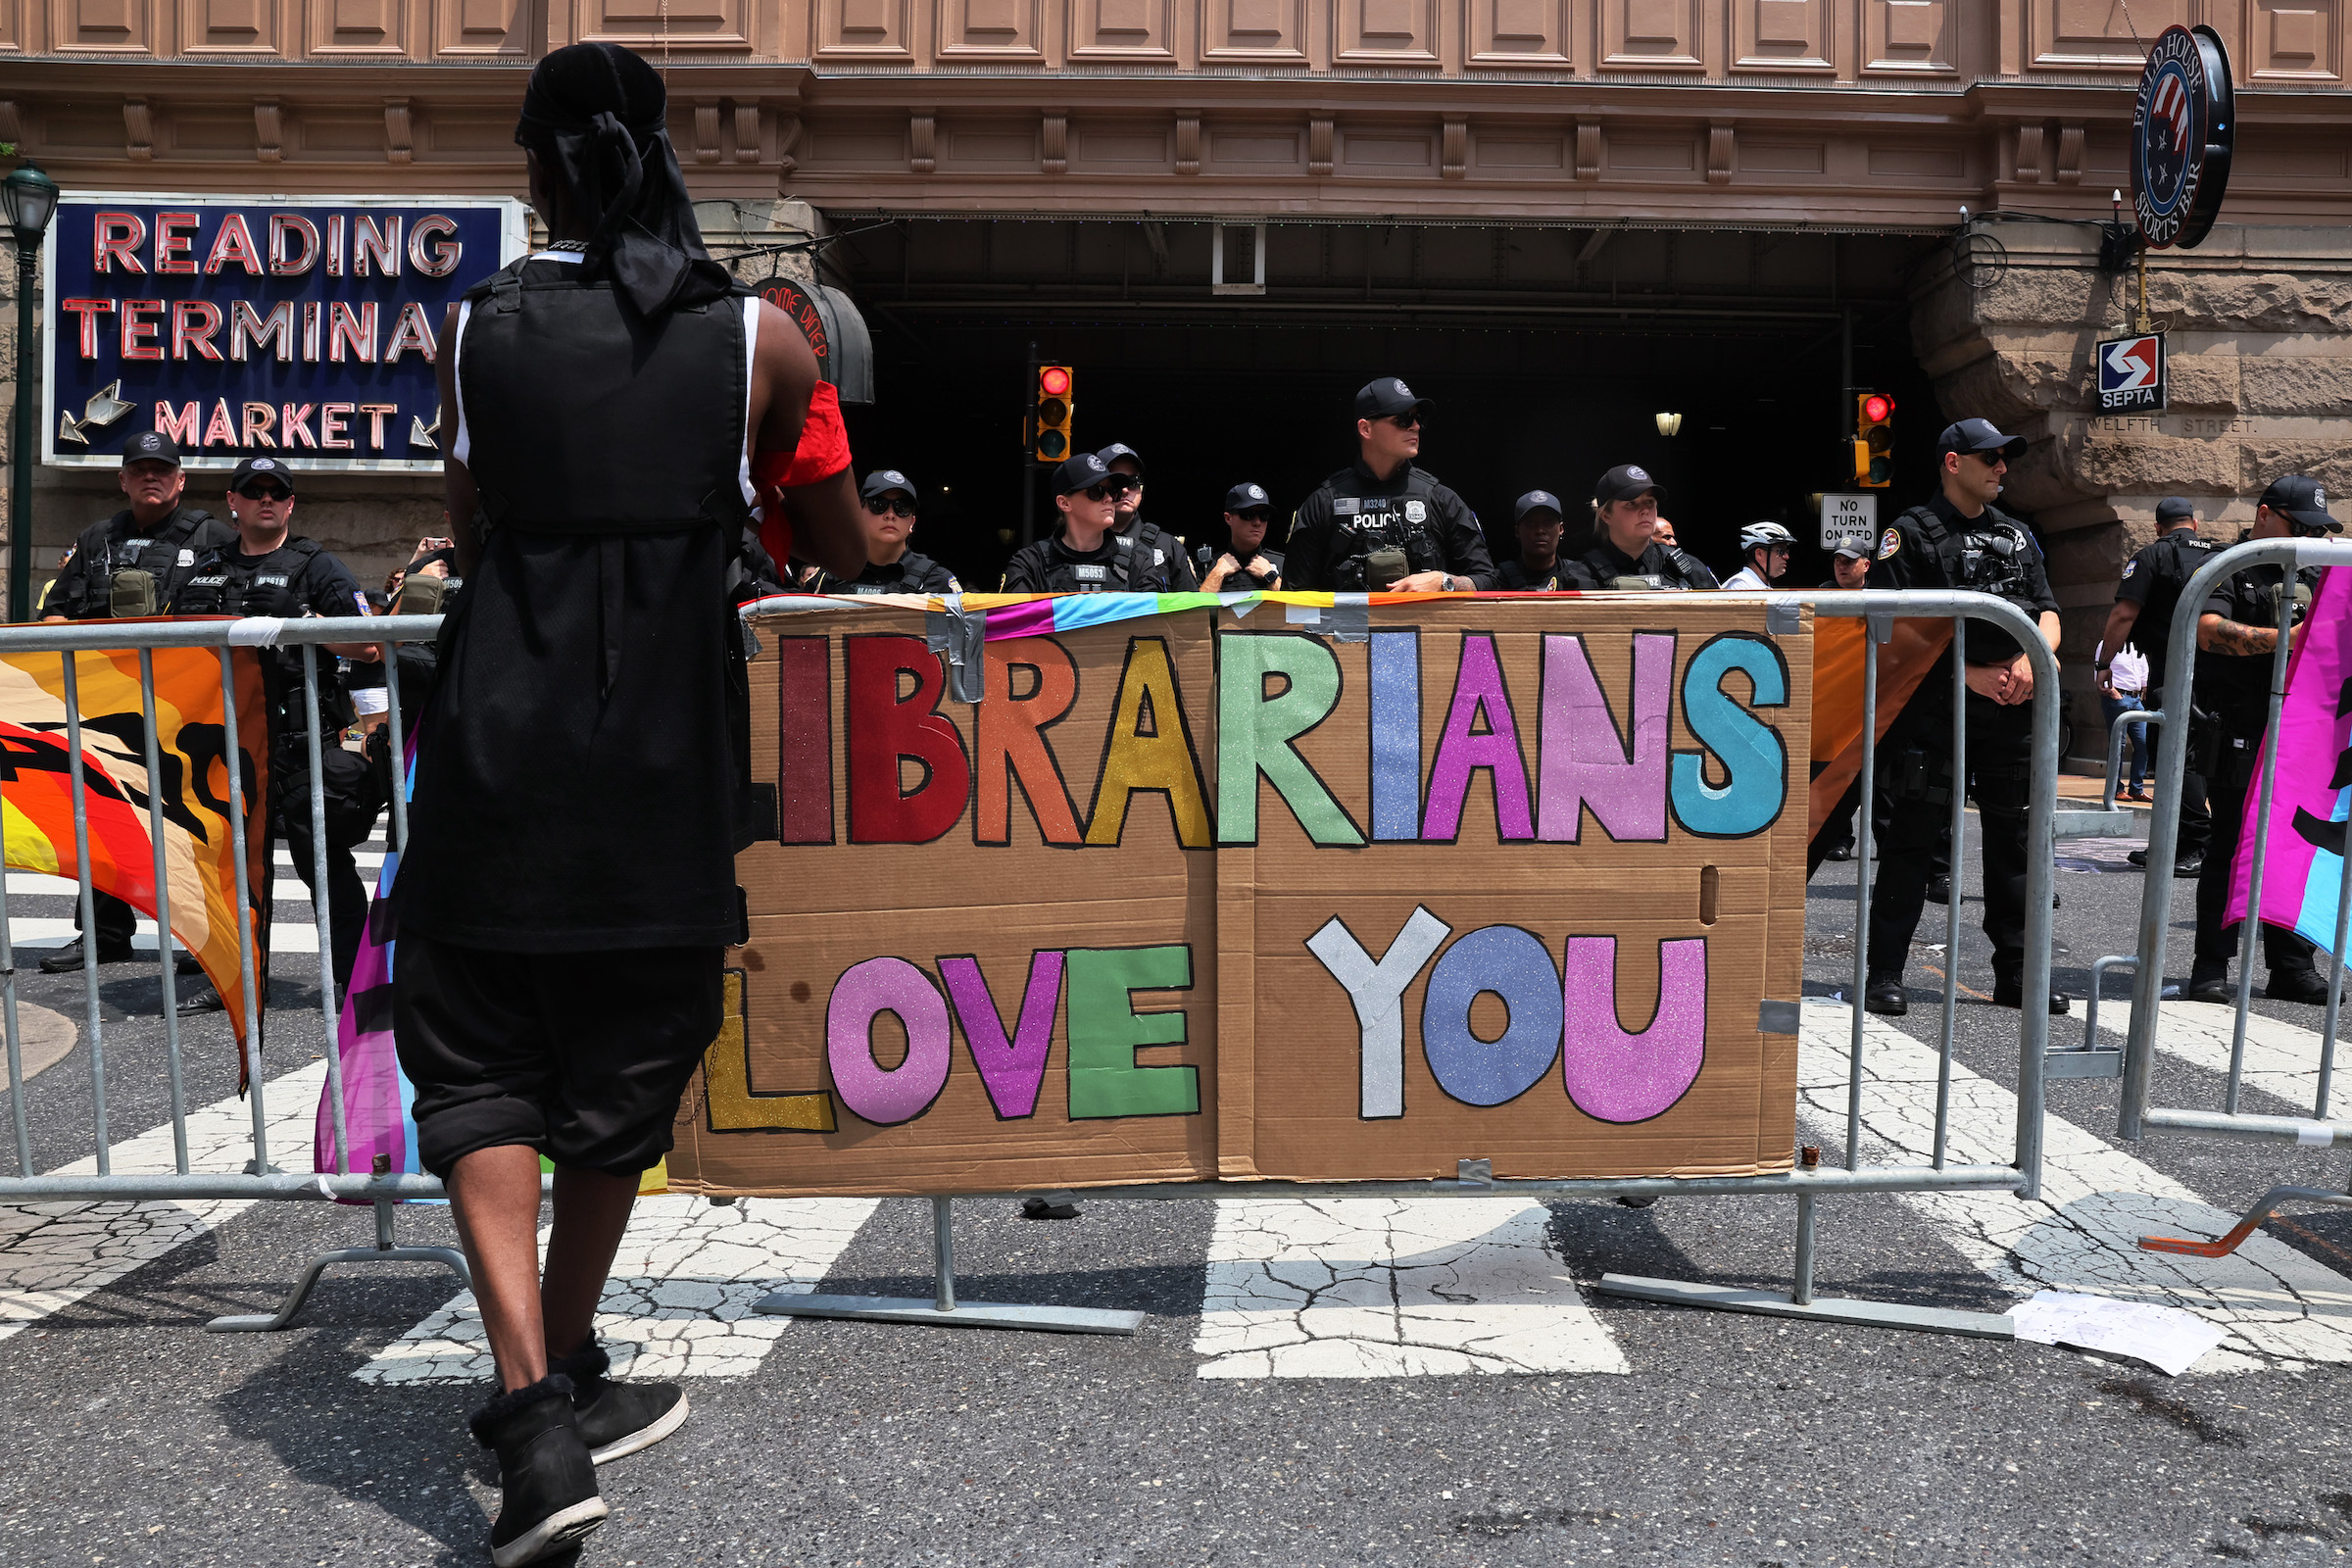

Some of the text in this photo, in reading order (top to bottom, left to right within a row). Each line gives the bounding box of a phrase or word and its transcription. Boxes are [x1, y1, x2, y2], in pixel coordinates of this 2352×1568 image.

[2132, 32, 2203, 128] FIELD HOUSE
[2134, 162, 2201, 242] SPORTS BAR
[94, 212, 463, 278] READING
[761, 287, 802, 315] OME
[63, 298, 461, 364] TERMINA
[2102, 390, 2156, 409] SEPTA
[154, 396, 398, 450] MARKET
[2076, 417, 2257, 433] TWELFTH STREET.
[1839, 500, 1858, 512] NO
[1832, 515, 1867, 526] TURN
[1116, 537, 1131, 547] 174
[1825, 529, 1842, 540] ON
[2188, 540, 2212, 550] POLICE
[190, 575, 224, 584] POLICE
[1078, 567, 1103, 578] M5053
[753, 628, 1789, 851] IBRARIANS
[706, 904, 1708, 1133] LOVE YOU
